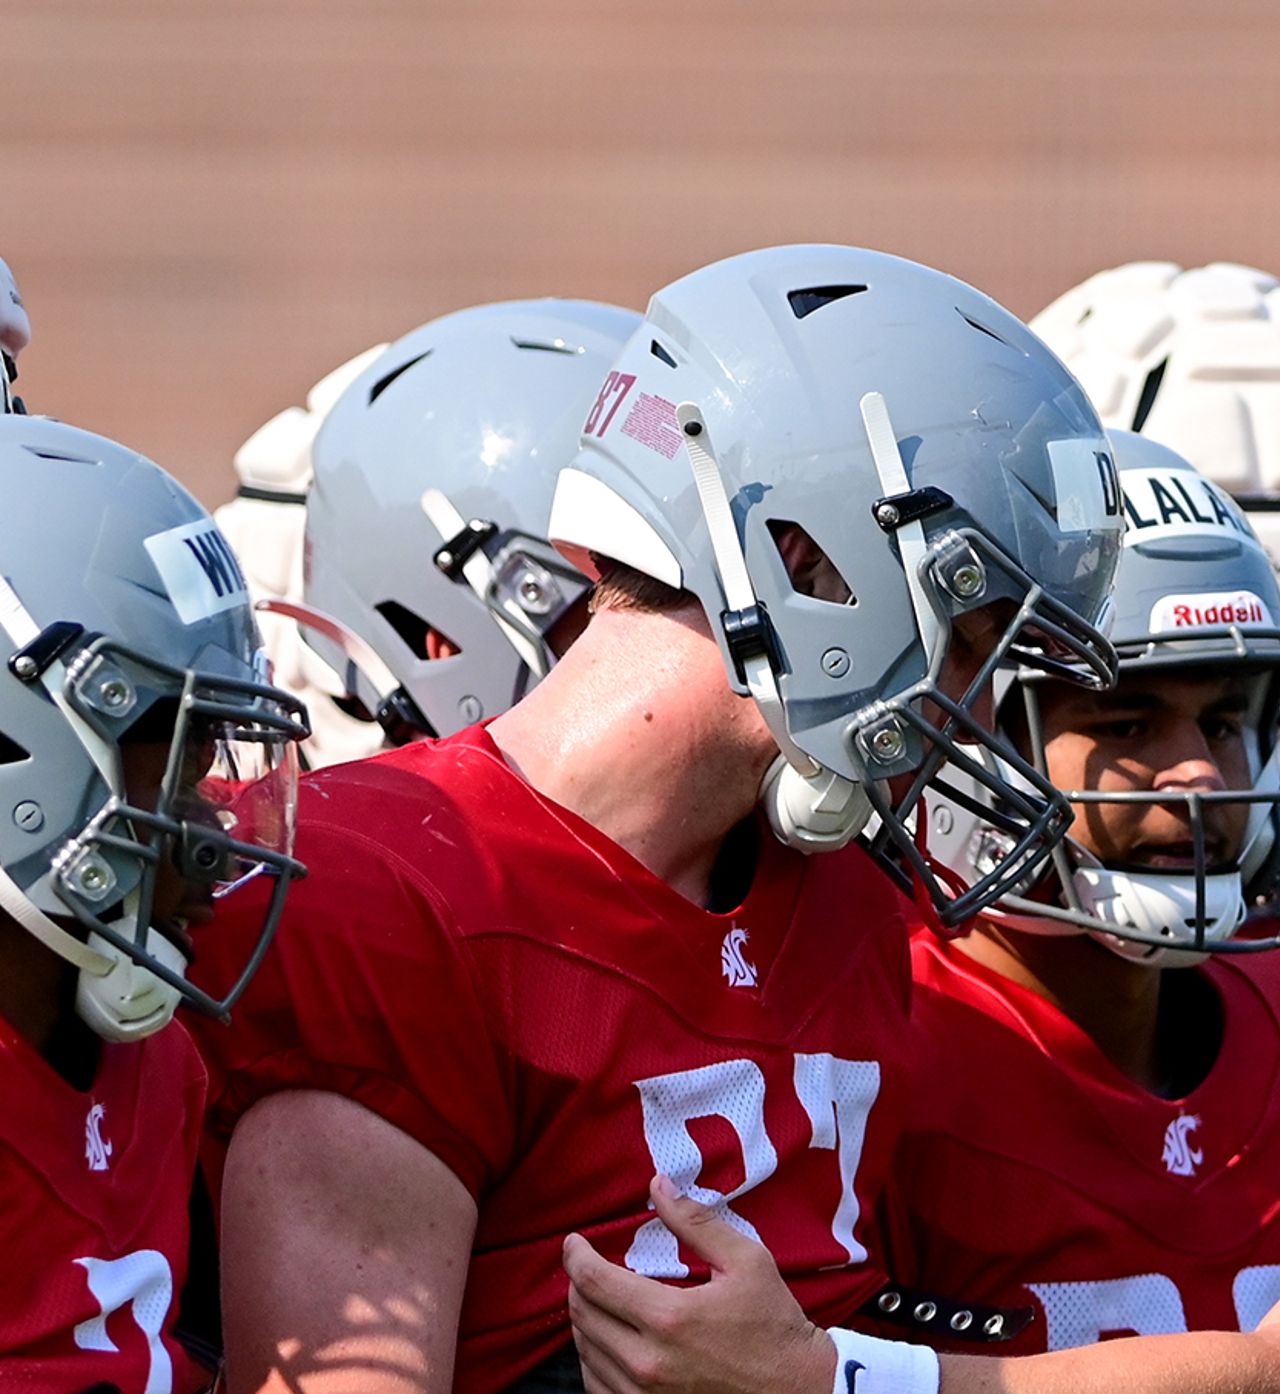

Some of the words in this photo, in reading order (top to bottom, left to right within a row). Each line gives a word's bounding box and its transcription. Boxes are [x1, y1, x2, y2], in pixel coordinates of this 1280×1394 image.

[584, 370, 637, 438] 87
[1120, 476, 1254, 534] LALA
[1173, 602, 1263, 627] Riddell
[624, 1052, 881, 1279] 87
